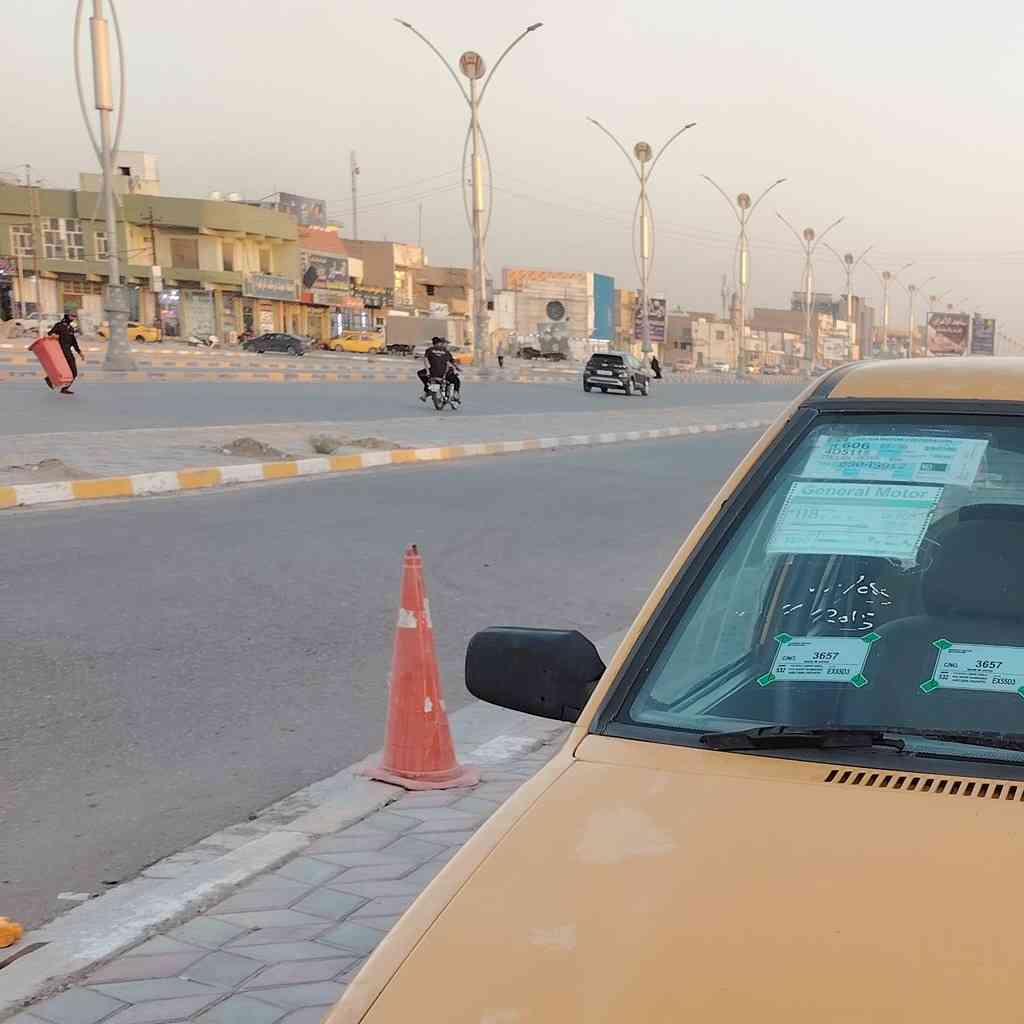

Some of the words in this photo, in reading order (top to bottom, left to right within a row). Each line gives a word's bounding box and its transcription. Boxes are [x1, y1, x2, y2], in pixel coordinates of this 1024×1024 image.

[801, 484, 871, 498] General
[874, 487, 928, 499] Motor
[812, 651, 840, 660] 3657
[975, 659, 1003, 669] 3657
